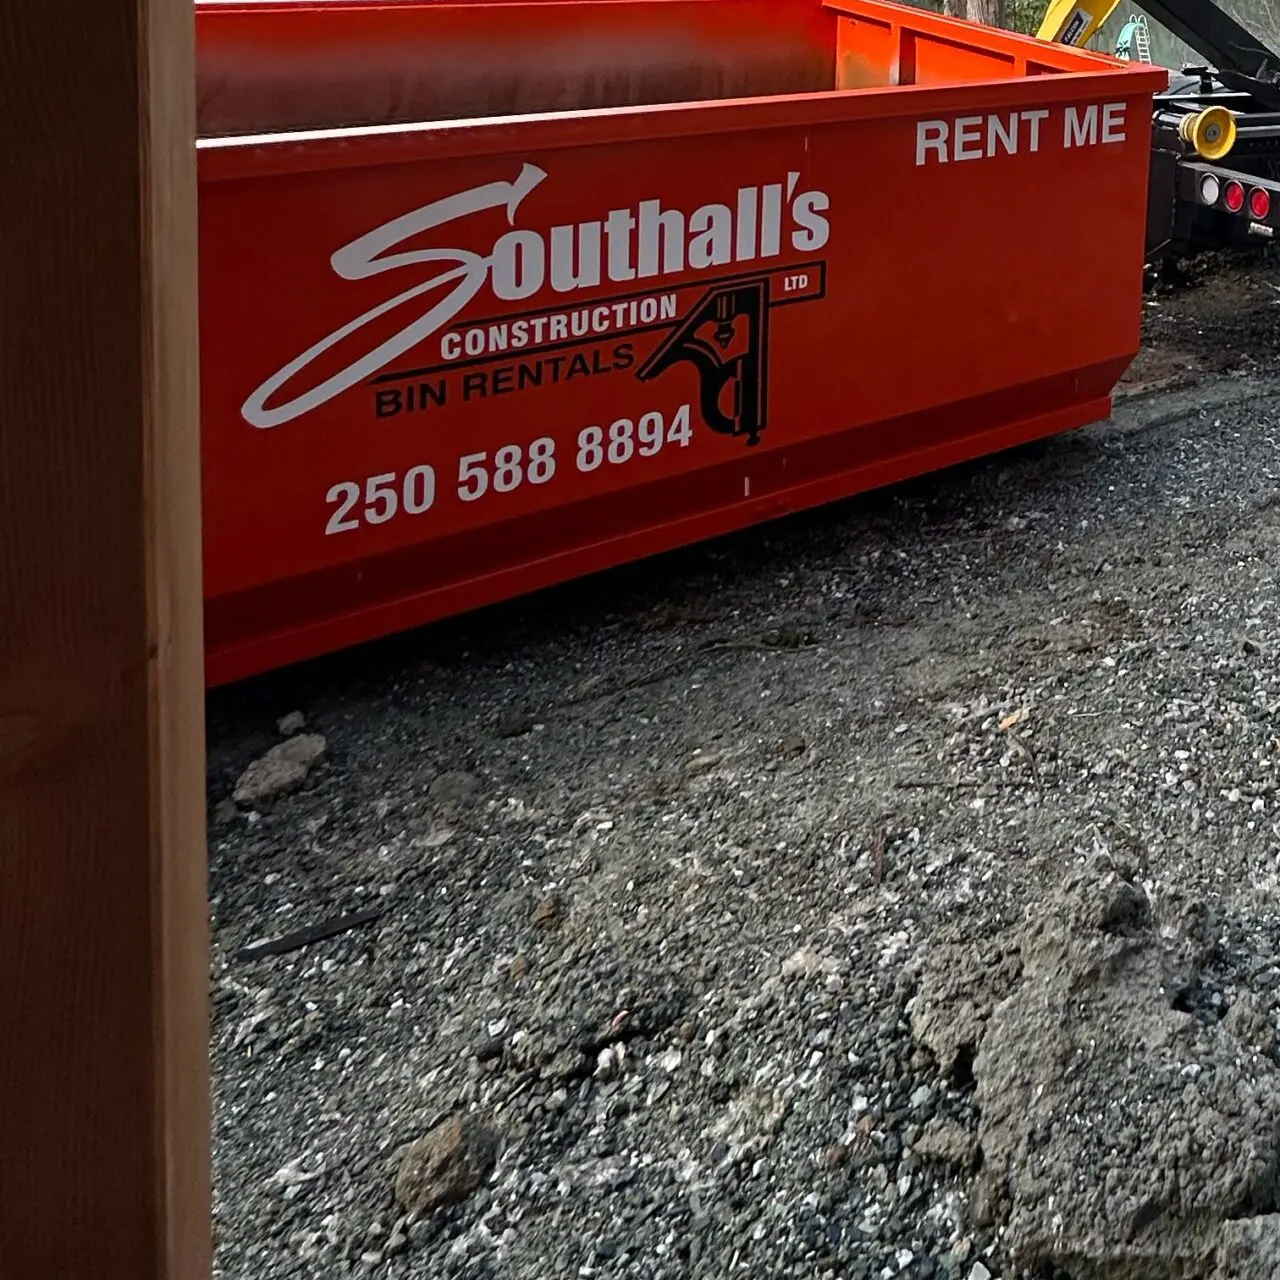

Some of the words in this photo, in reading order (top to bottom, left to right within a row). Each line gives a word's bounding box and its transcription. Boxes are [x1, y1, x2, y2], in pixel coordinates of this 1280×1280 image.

[916, 109, 1049, 166] RENT
[1063, 102, 1127, 149] ME
[240, 162, 831, 429] Southall's
[440, 294, 677, 361] CONSTRUCTION
[784, 274, 809, 293] LTD
[374, 378, 448, 420] BIN
[461, 343, 637, 403] RENTALS
[324, 464, 437, 536] 250
[457, 436, 557, 503] 588
[575, 404, 694, 473] 8894
